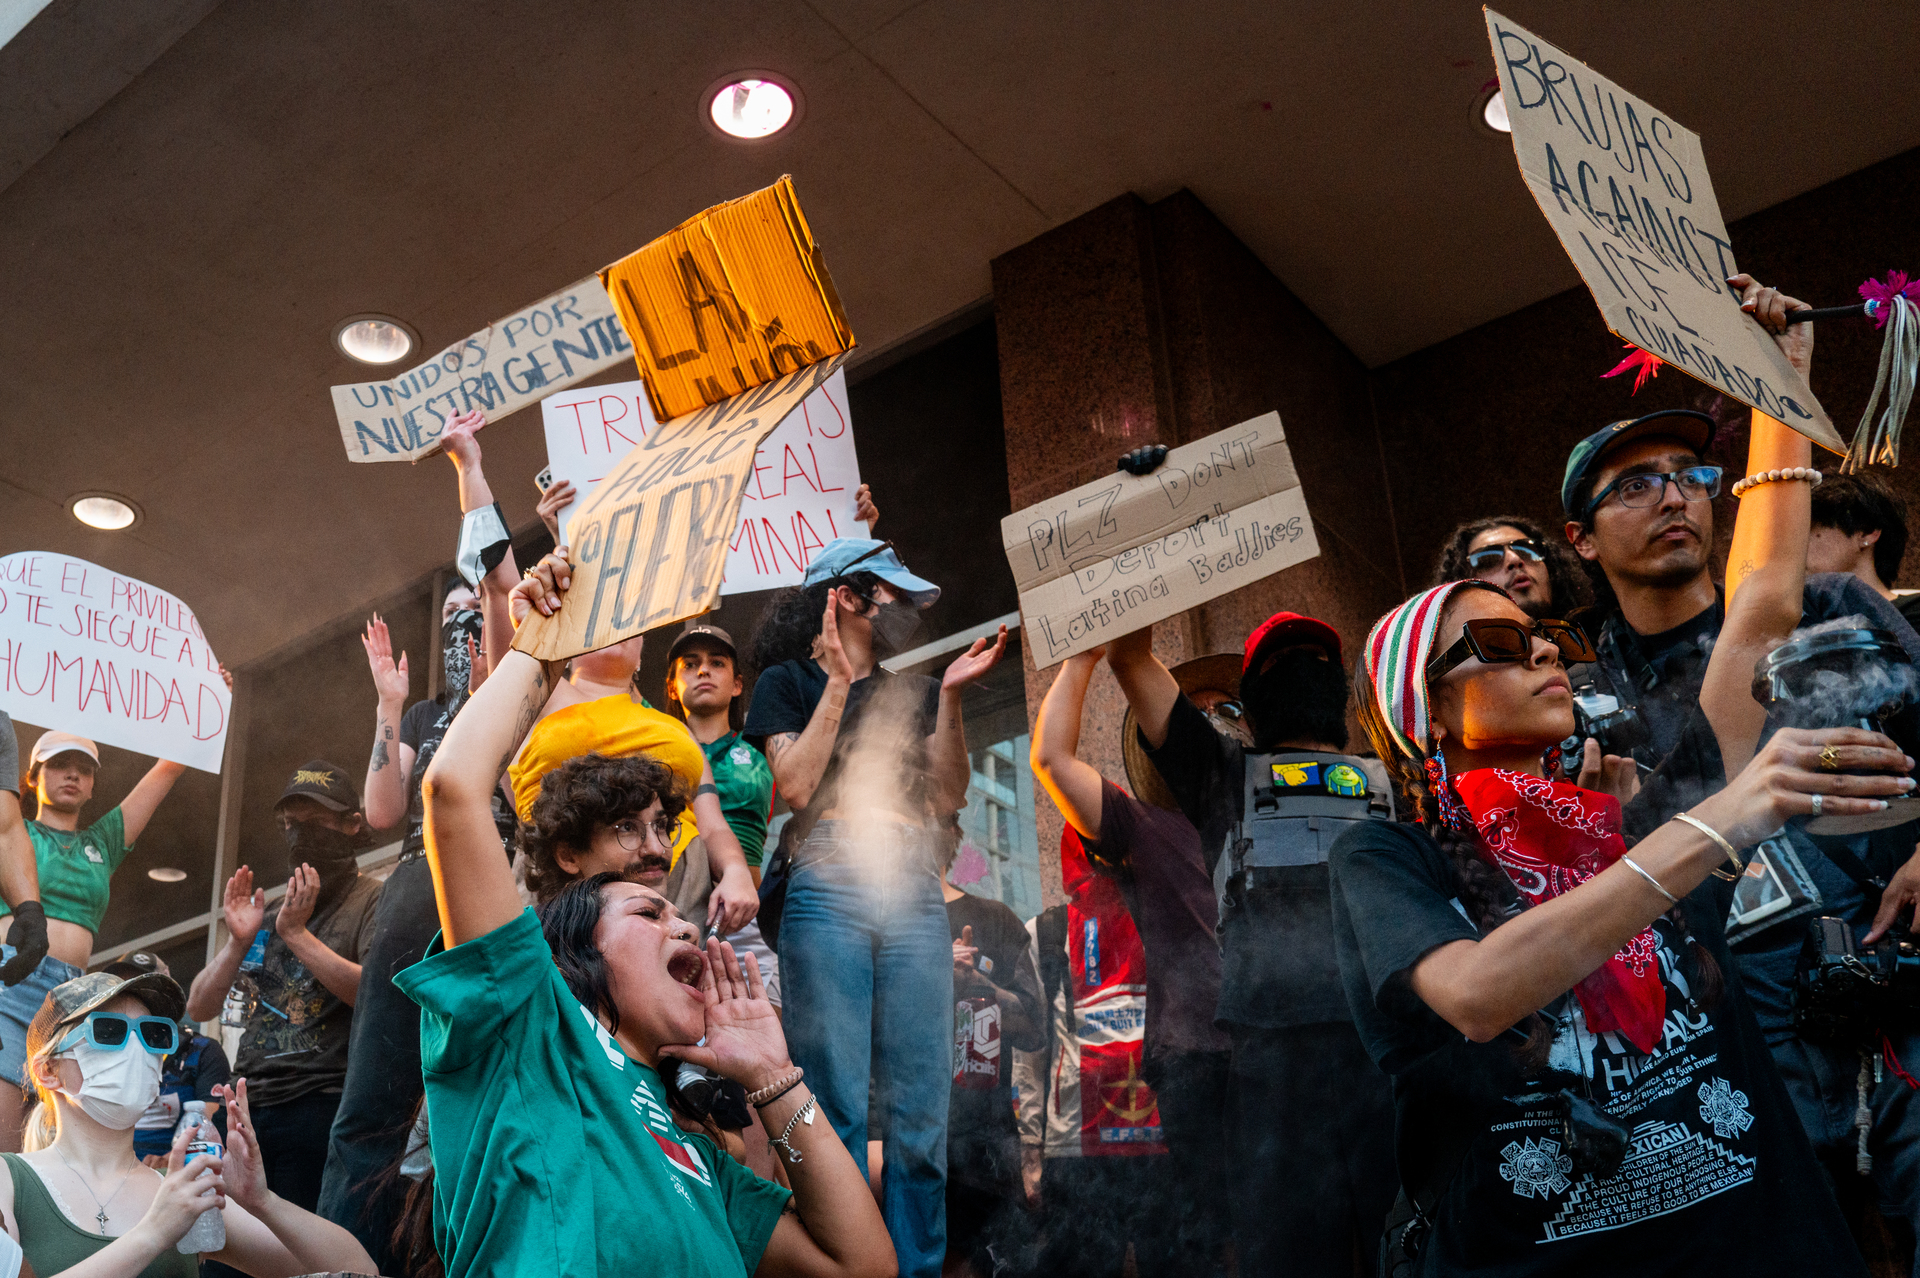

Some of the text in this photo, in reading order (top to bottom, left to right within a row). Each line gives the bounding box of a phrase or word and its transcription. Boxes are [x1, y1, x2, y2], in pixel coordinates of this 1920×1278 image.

[1495, 23, 1692, 204] BRUJAS
[1546, 142, 1744, 311] AGAINST
[621, 250, 748, 371] LA
[1579, 230, 1699, 336] ICE
[352, 295, 583, 408] UNIDOS POR
[354, 313, 633, 456] NUESTRA GENTE
[744, 443, 844, 500] EAL
[722, 509, 838, 583] MINA
[1028, 484, 1122, 571] PLZ
[16, 592, 53, 627] TE
[59, 604, 167, 659] SIEGUE
[178, 637, 194, 667] A
[206, 648, 222, 676] L
[61, 563, 93, 598] EL
[111, 577, 203, 641] PRIVILEG
[1038, 575, 1169, 658] Latina
[0, 638, 224, 741] HUMANIDAD
[1490, 1118, 1562, 1132] CONSTITUTIONA
[1536, 1110, 1553, 1118] THE
[1620, 1092, 1632, 1101] OF
[1624, 1127, 1685, 1159] EXICAN
[1569, 1164, 1739, 1224] BECAUSE WE REFUSE TO BE ANYTHING ELSE
[1578, 1158, 1726, 1213] THE CULTURE OF OUR CHOOSING
[1584, 1151, 1715, 1201] A PROUD INDIGENOUS PEOPLE
[1590, 1181, 1598, 1189] A
[1625, 1160, 1672, 1180] CULTURAL
[1671, 1145, 1706, 1165] HERITAGE
[1617, 1141, 1697, 1173] CHILDREN OF THE SUN
[1559, 1166, 1754, 1235] BECAUSE IT FEELS SO GOOD TO BE MEXICAN!
